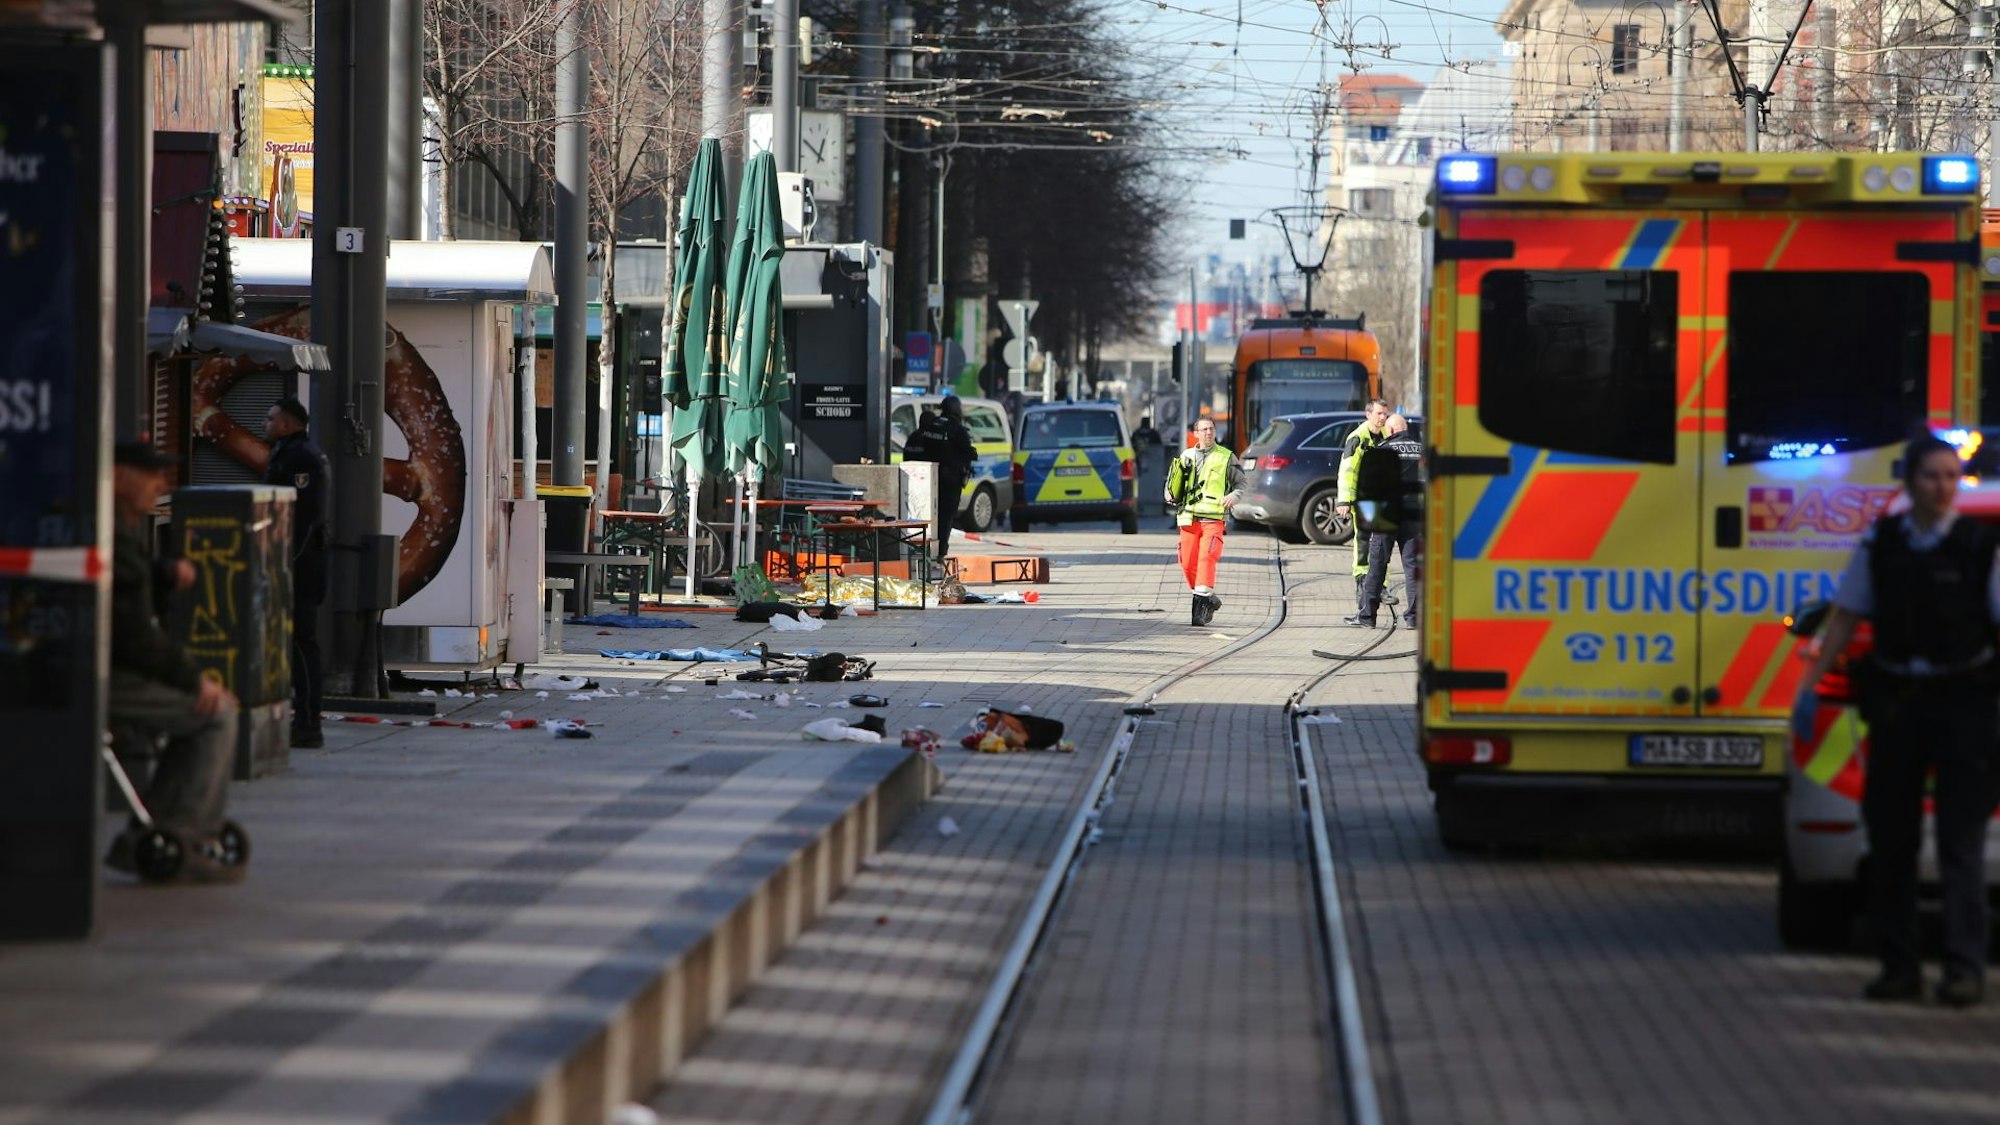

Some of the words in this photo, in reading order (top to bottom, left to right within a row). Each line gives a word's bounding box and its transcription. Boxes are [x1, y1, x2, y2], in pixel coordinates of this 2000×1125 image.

[346, 233, 354, 251] 3
[908, 359, 929, 367] TAXI
[816, 407, 852, 418] SCHOKO
[1614, 633, 1675, 664] 112
